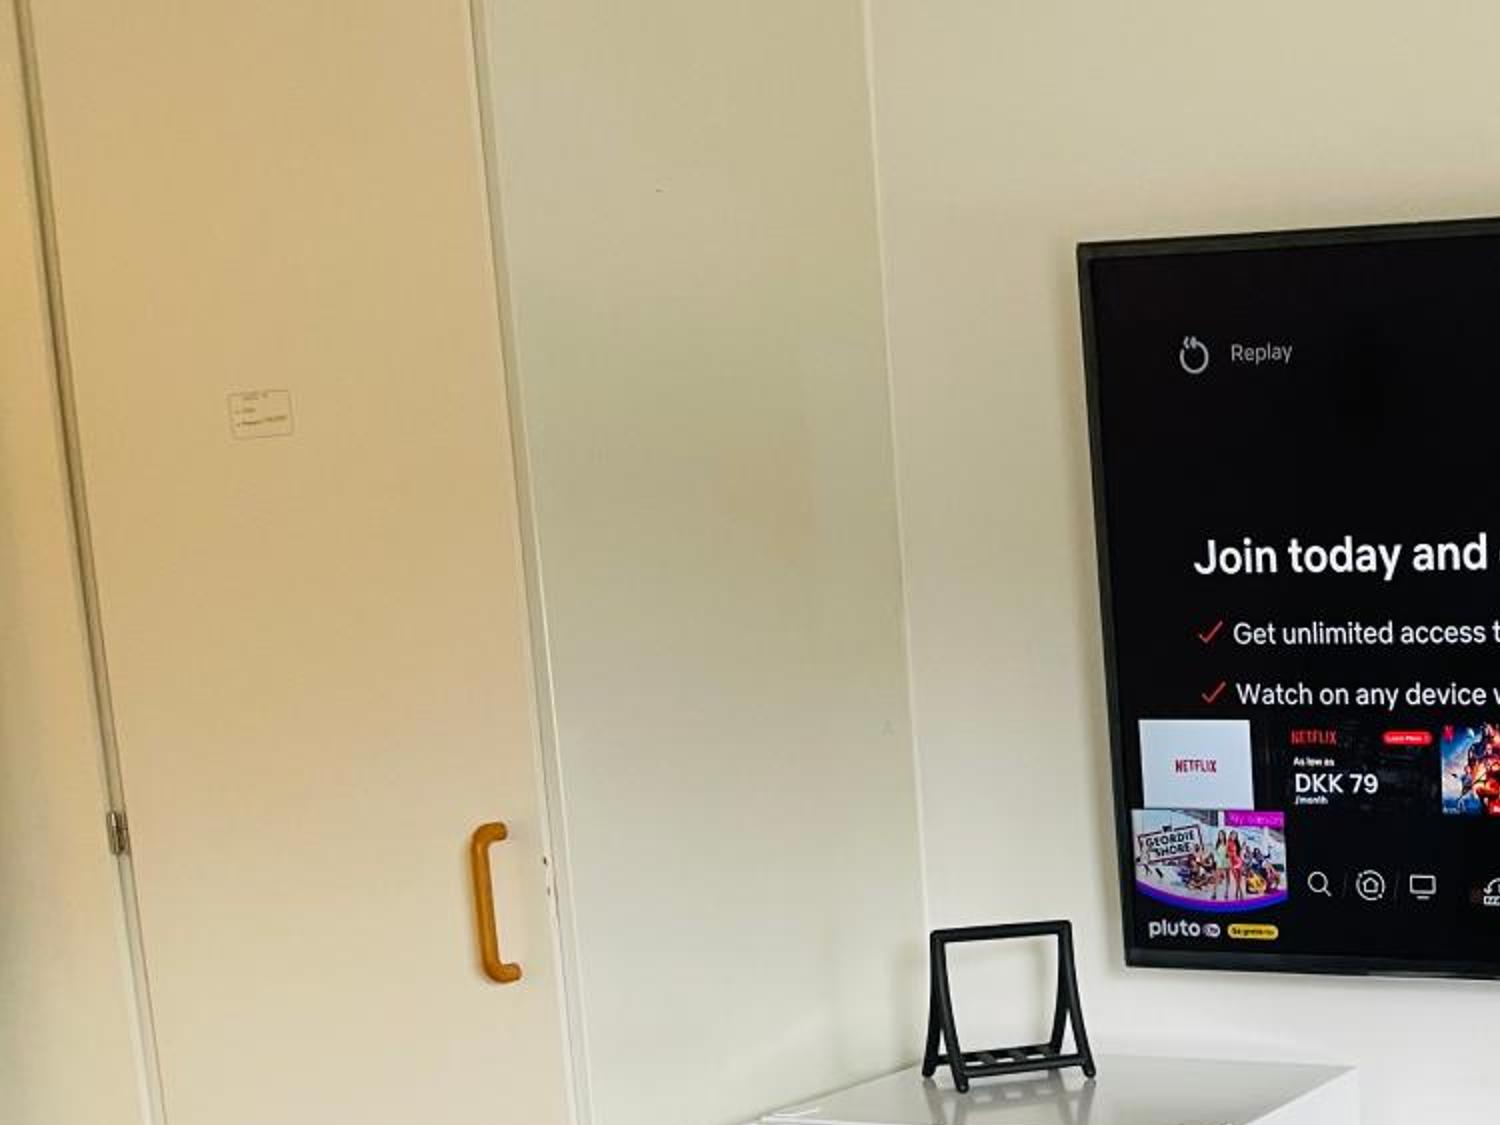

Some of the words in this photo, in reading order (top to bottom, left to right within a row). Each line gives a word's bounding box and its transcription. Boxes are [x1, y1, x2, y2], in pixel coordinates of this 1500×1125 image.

[1231, 341, 1293, 364] Replay
[1193, 537, 1278, 576] Join
[1287, 535, 1402, 581] today
[1412, 532, 1488, 572] and
[1233, 622, 1277, 645] Get
[1282, 620, 1394, 645] unlimited
[1400, 625, 1487, 644] access
[1235, 682, 1313, 706] Watch
[1319, 687, 1349, 706] on
[1355, 687, 1399, 712] any
[1405, 682, 1487, 706] device
[1290, 729, 1337, 745] NETFLIX
[1175, 758, 1217, 773] NETFLIX
[1293, 756, 1305, 767] As
[1295, 773, 1344, 794] DKK
[1349, 773, 1379, 794] 79
[1145, 830, 1194, 847] GEORDIE
[1148, 919, 1200, 939] pluto
